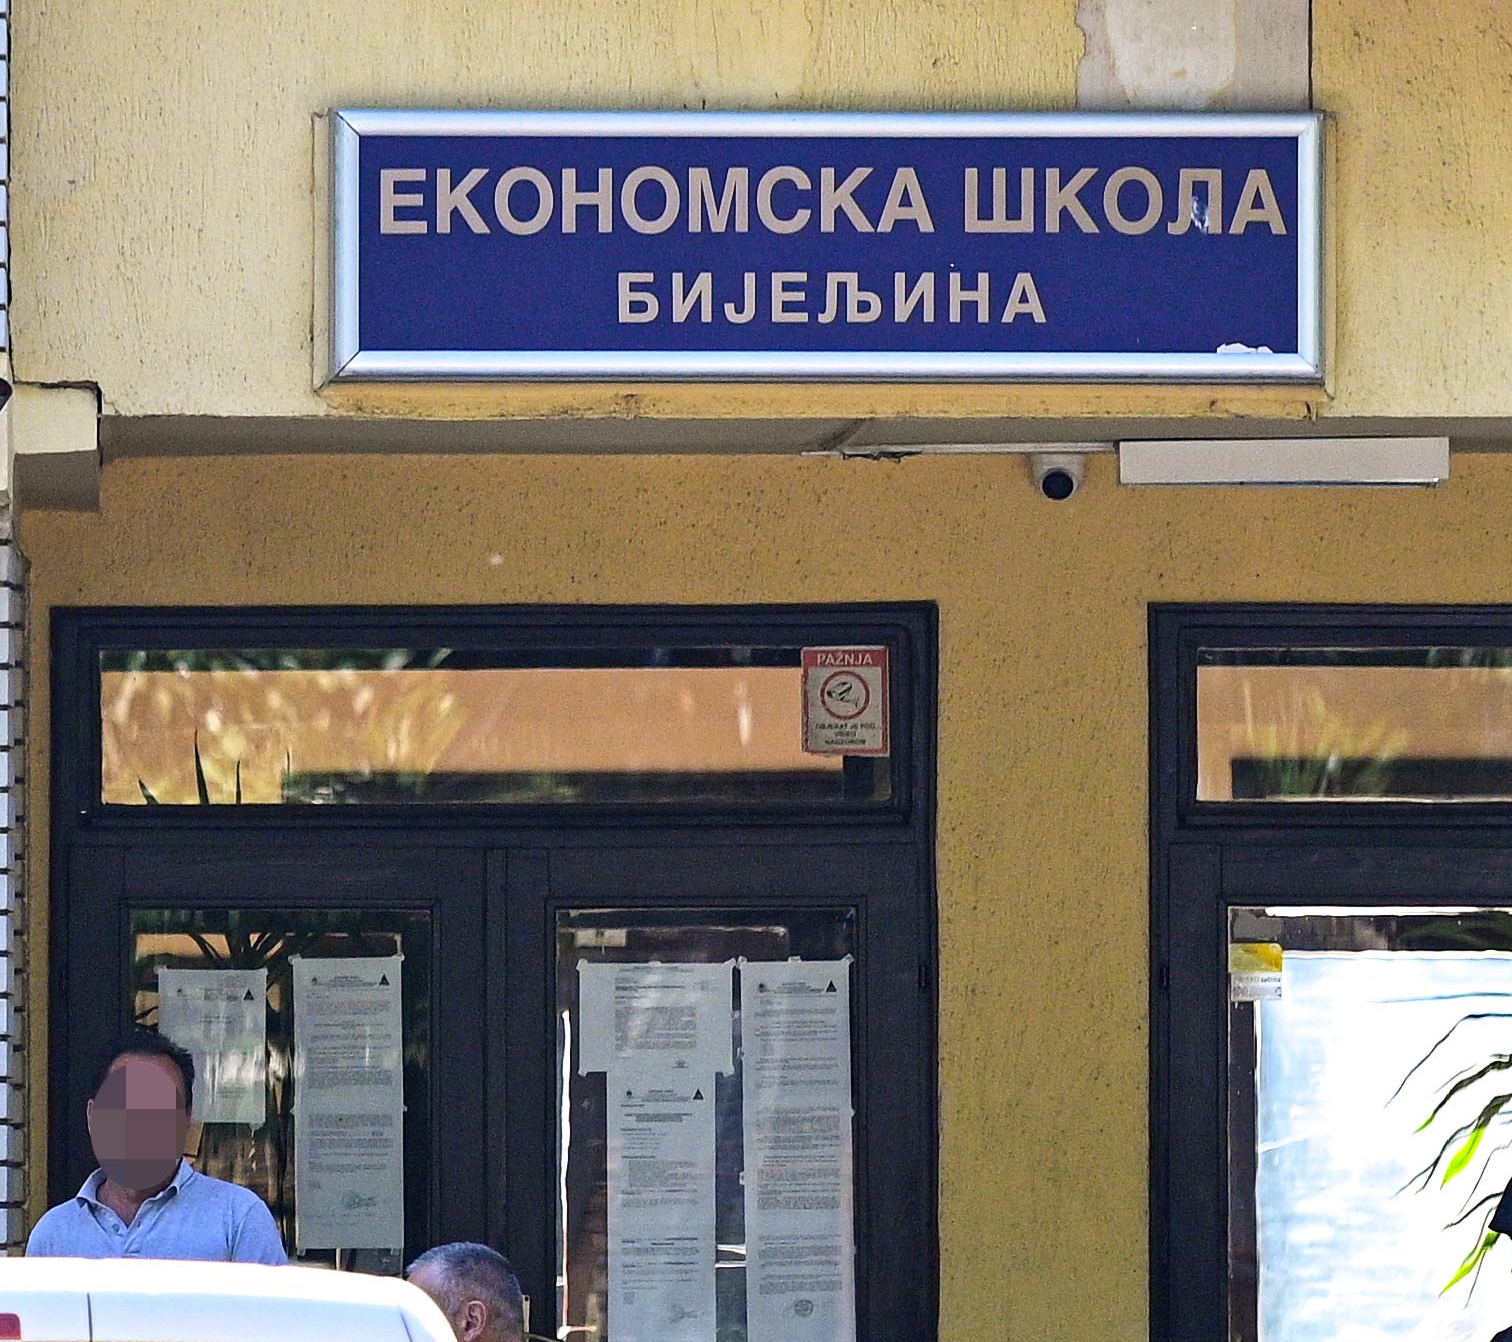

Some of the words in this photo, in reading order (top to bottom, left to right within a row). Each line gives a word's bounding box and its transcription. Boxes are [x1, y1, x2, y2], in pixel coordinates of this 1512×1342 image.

[378, 165, 936, 236] ЕКОНОМСКА
[963, 165, 1288, 236] ШКОЛА
[617, 271, 1048, 325] БИЈЕЉИНА
[816, 651, 873, 666] PAŽNJA
